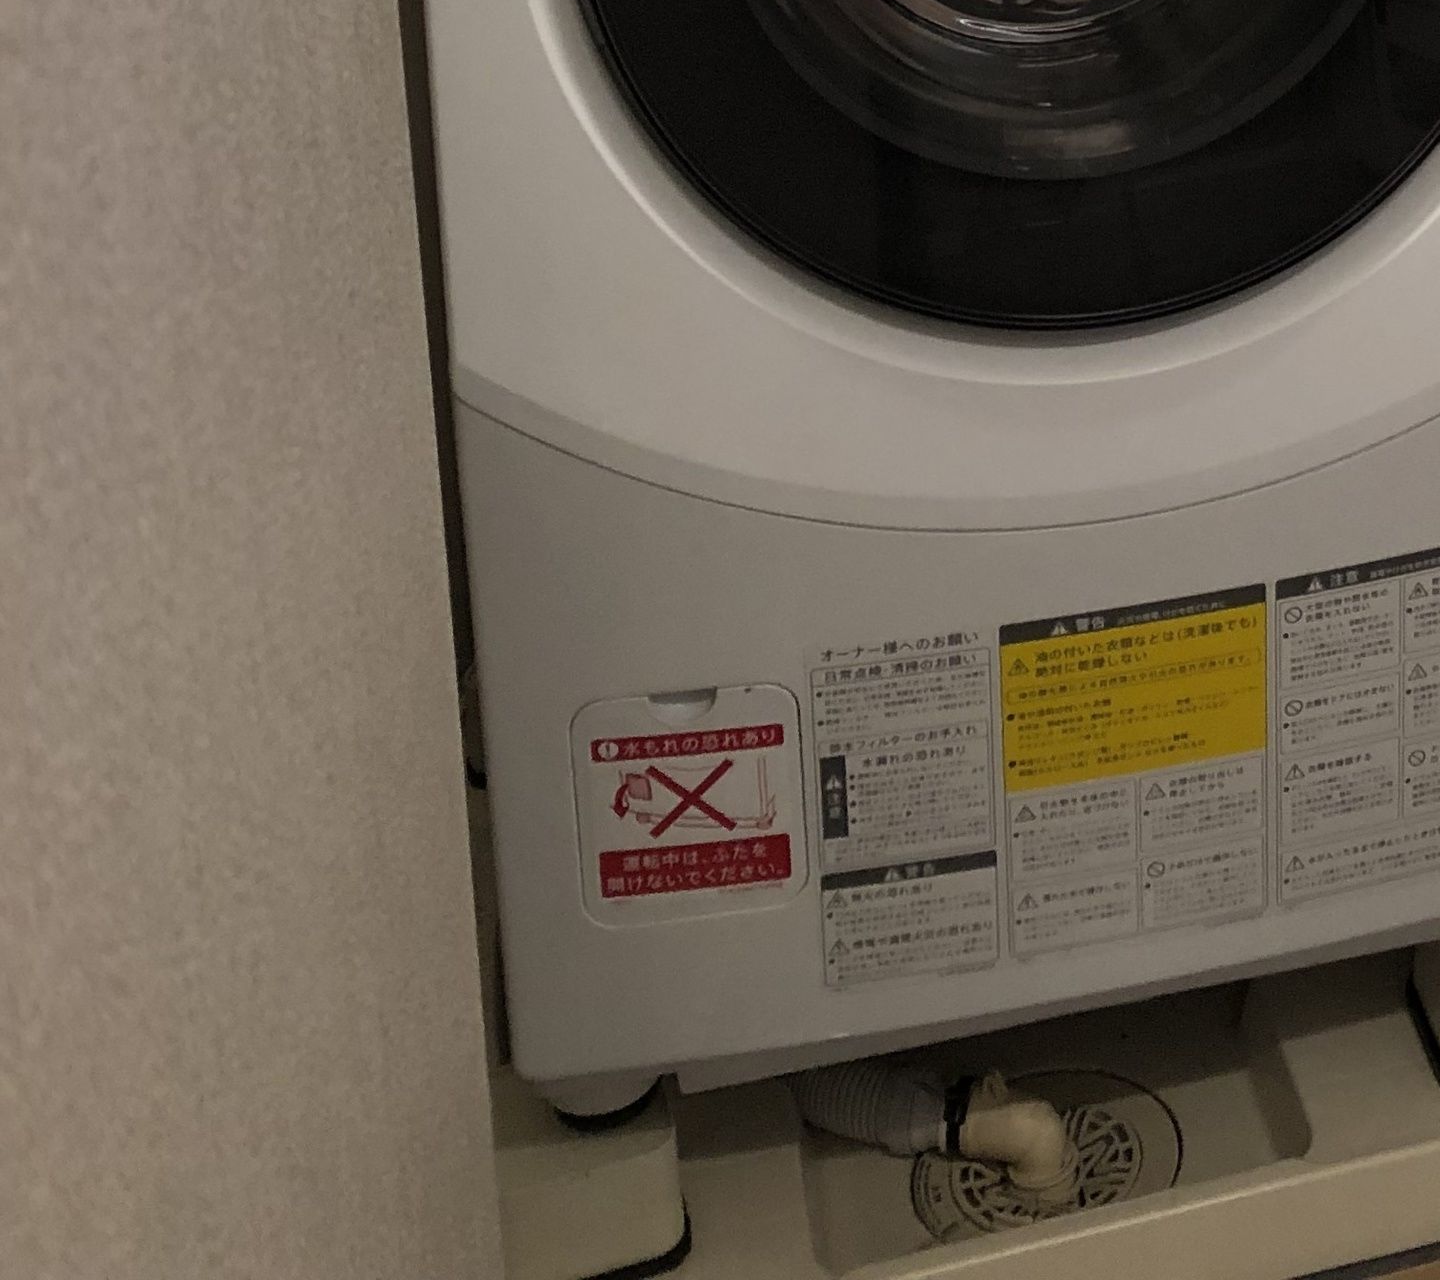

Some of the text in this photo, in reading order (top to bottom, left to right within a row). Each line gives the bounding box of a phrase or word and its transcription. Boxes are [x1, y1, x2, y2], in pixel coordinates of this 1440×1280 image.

[821, 632, 978, 662] オーナー様へのお願い
